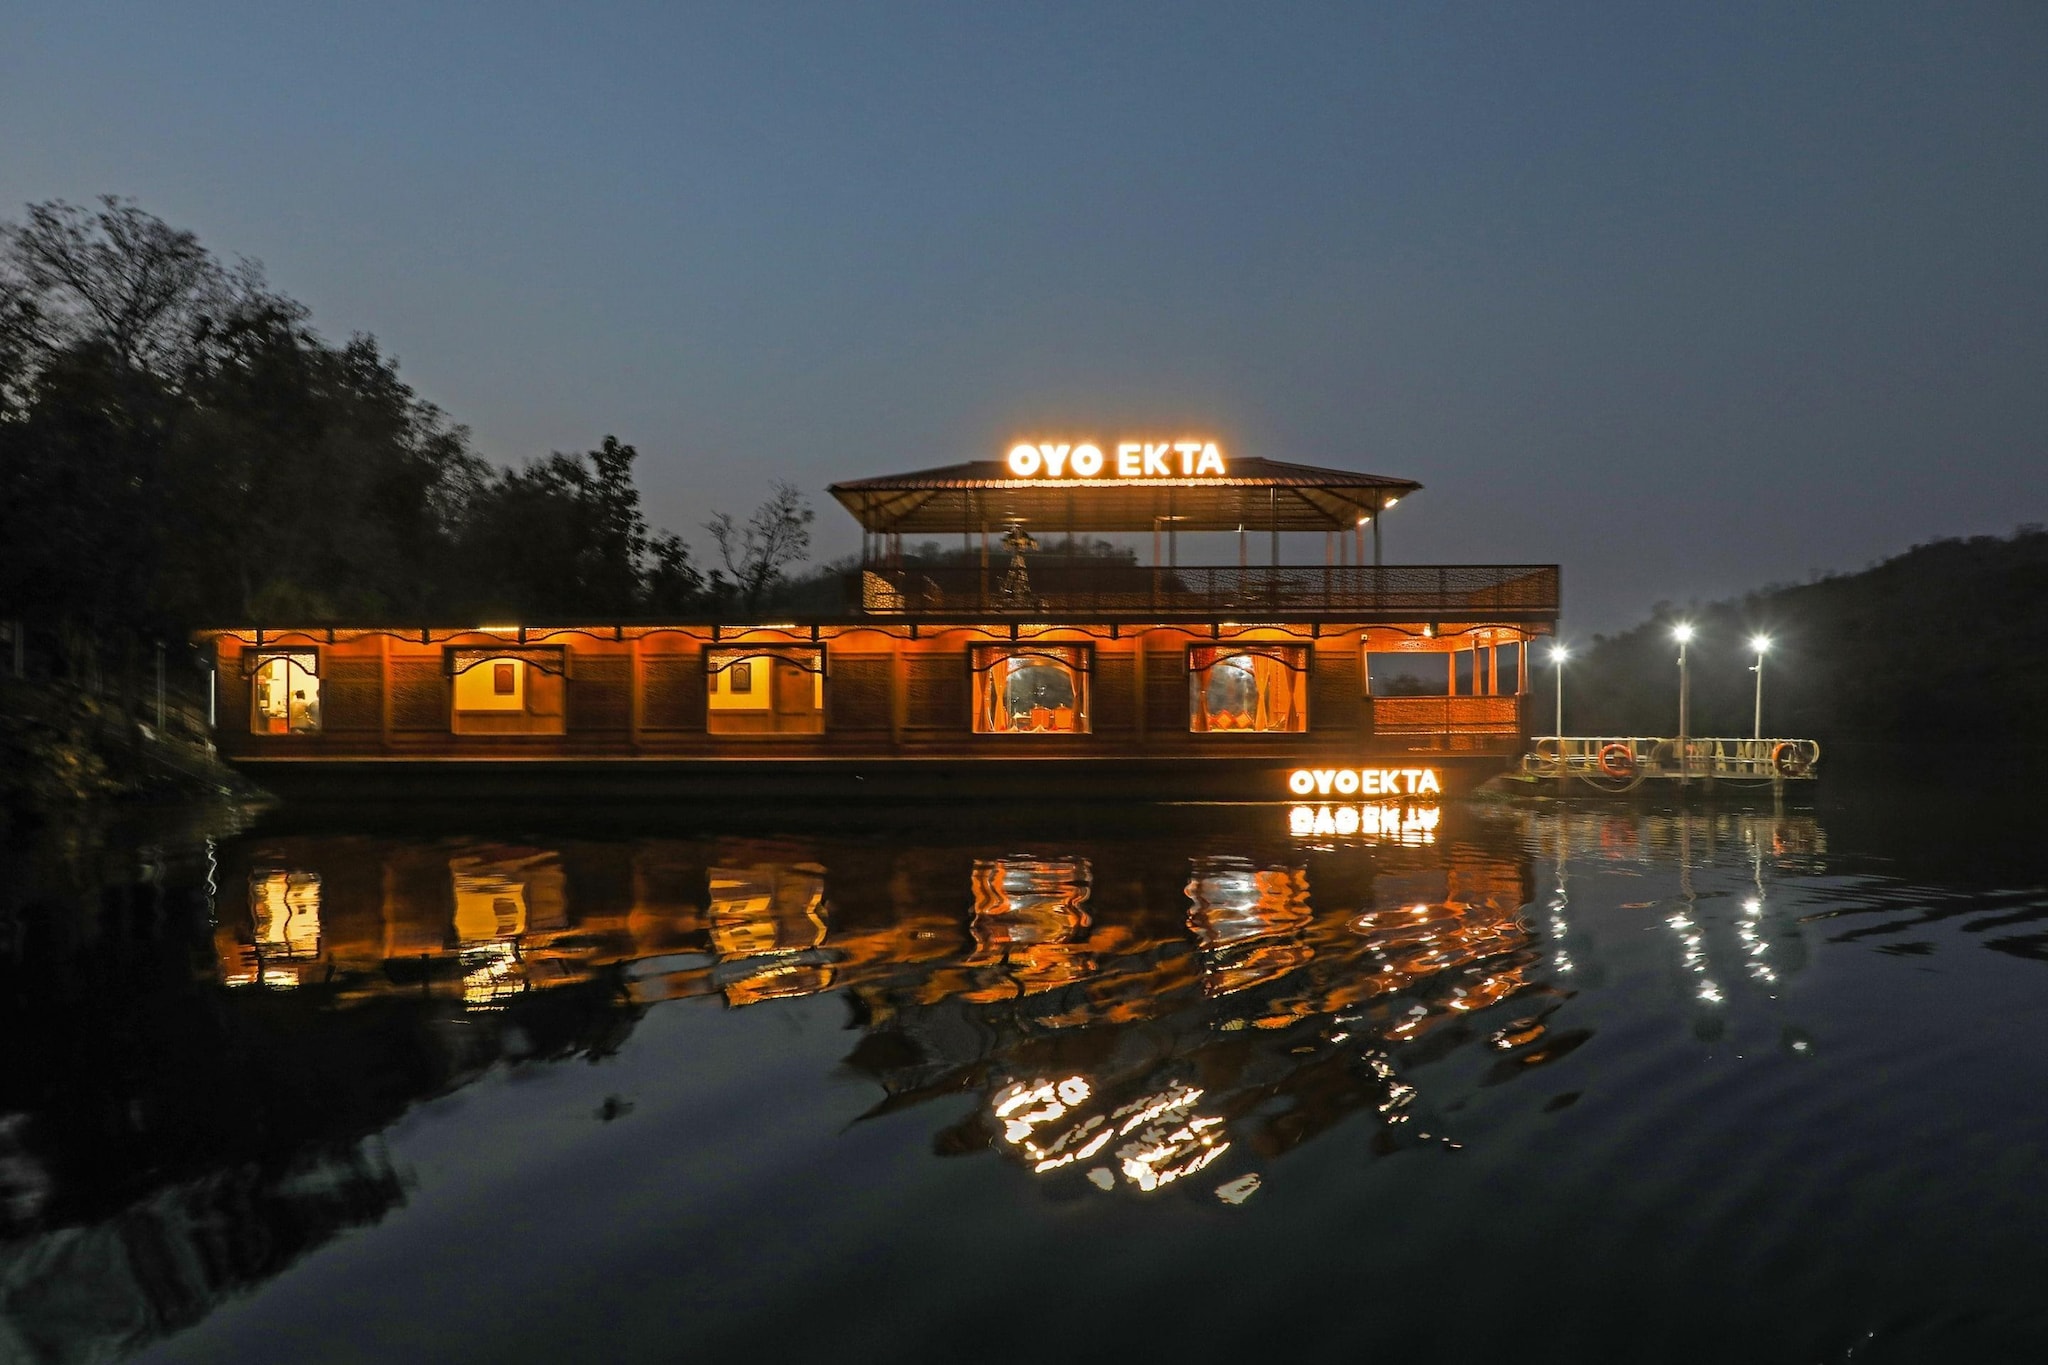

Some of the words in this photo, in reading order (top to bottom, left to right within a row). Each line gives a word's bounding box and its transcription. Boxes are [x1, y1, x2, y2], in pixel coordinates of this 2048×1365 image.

[1007, 443, 1104, 477] OYO
[1116, 442, 1226, 476] EKTA
[1289, 769, 1360, 795] OYO
[1361, 769, 1440, 795] EKTA
